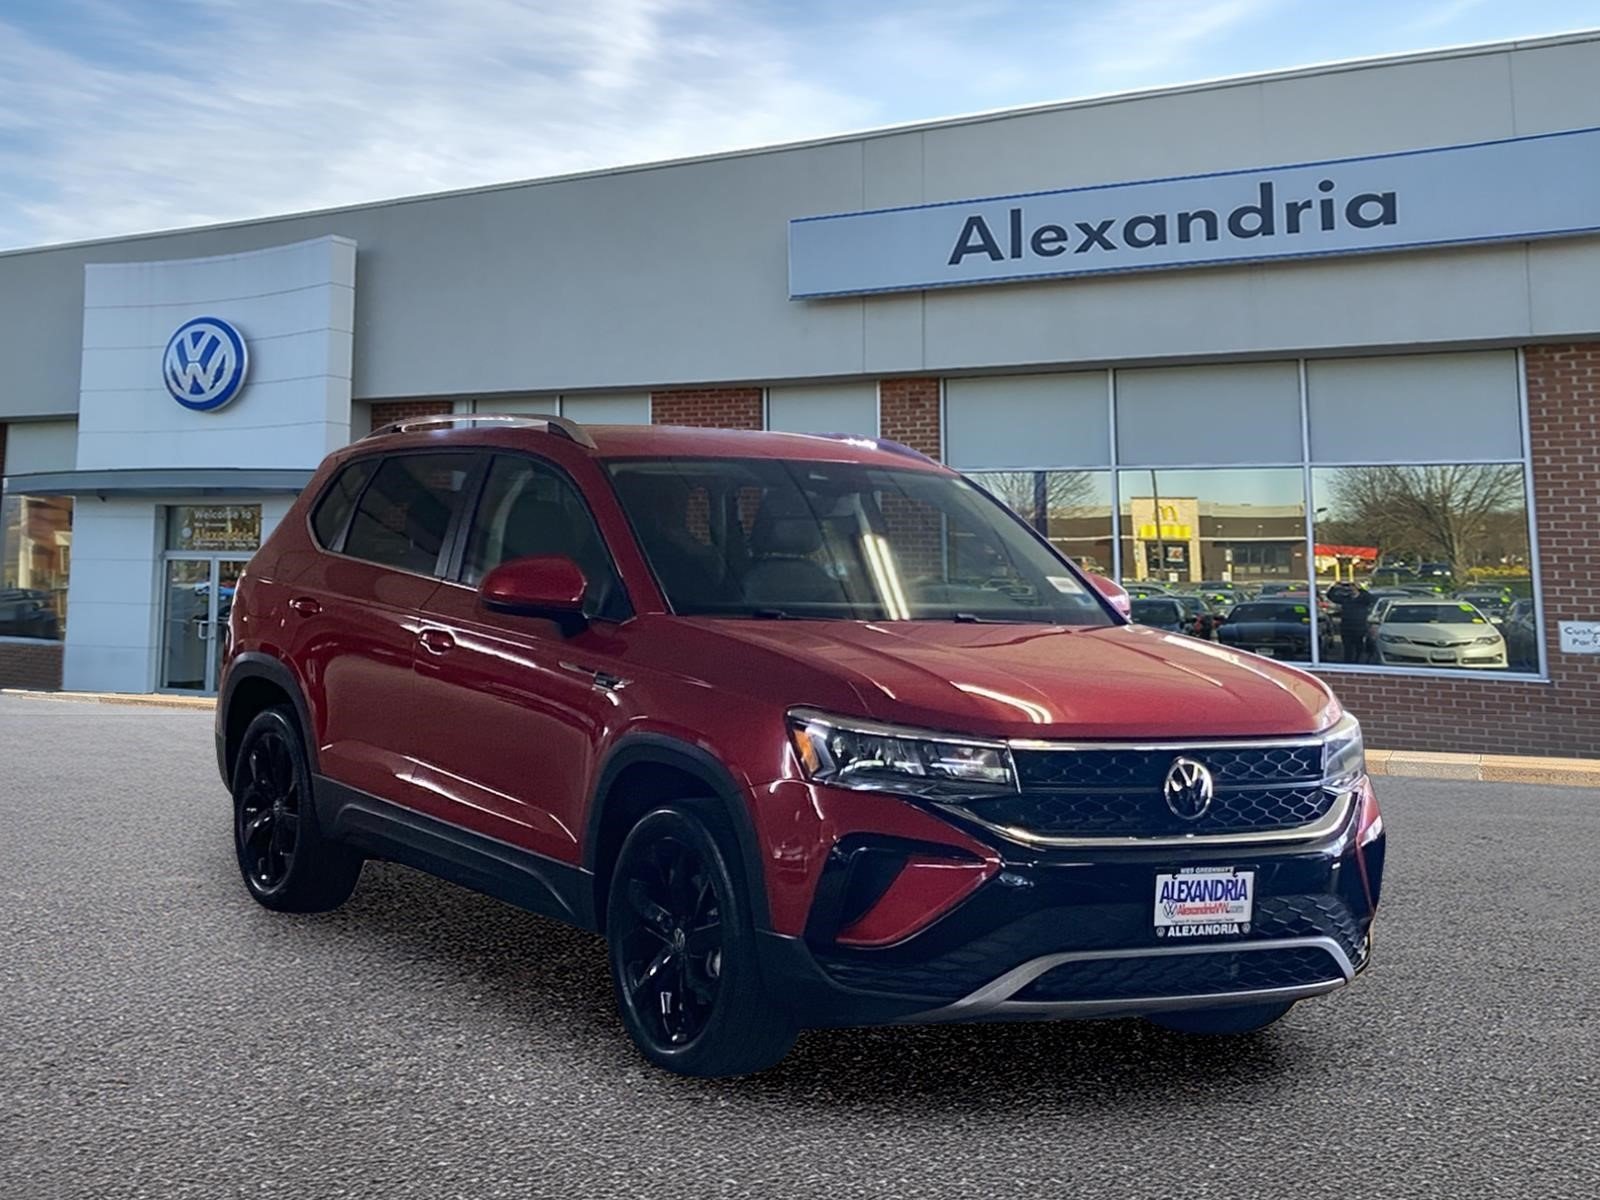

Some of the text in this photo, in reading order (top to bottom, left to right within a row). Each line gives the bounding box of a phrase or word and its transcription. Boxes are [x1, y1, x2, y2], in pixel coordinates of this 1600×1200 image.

[947, 179, 1398, 266] Alexandria
[194, 510, 252, 519] Welcome to
[1159, 878, 1248, 903] ALEXANDRIA
[1167, 923, 1240, 937] ALEXANDRIA
